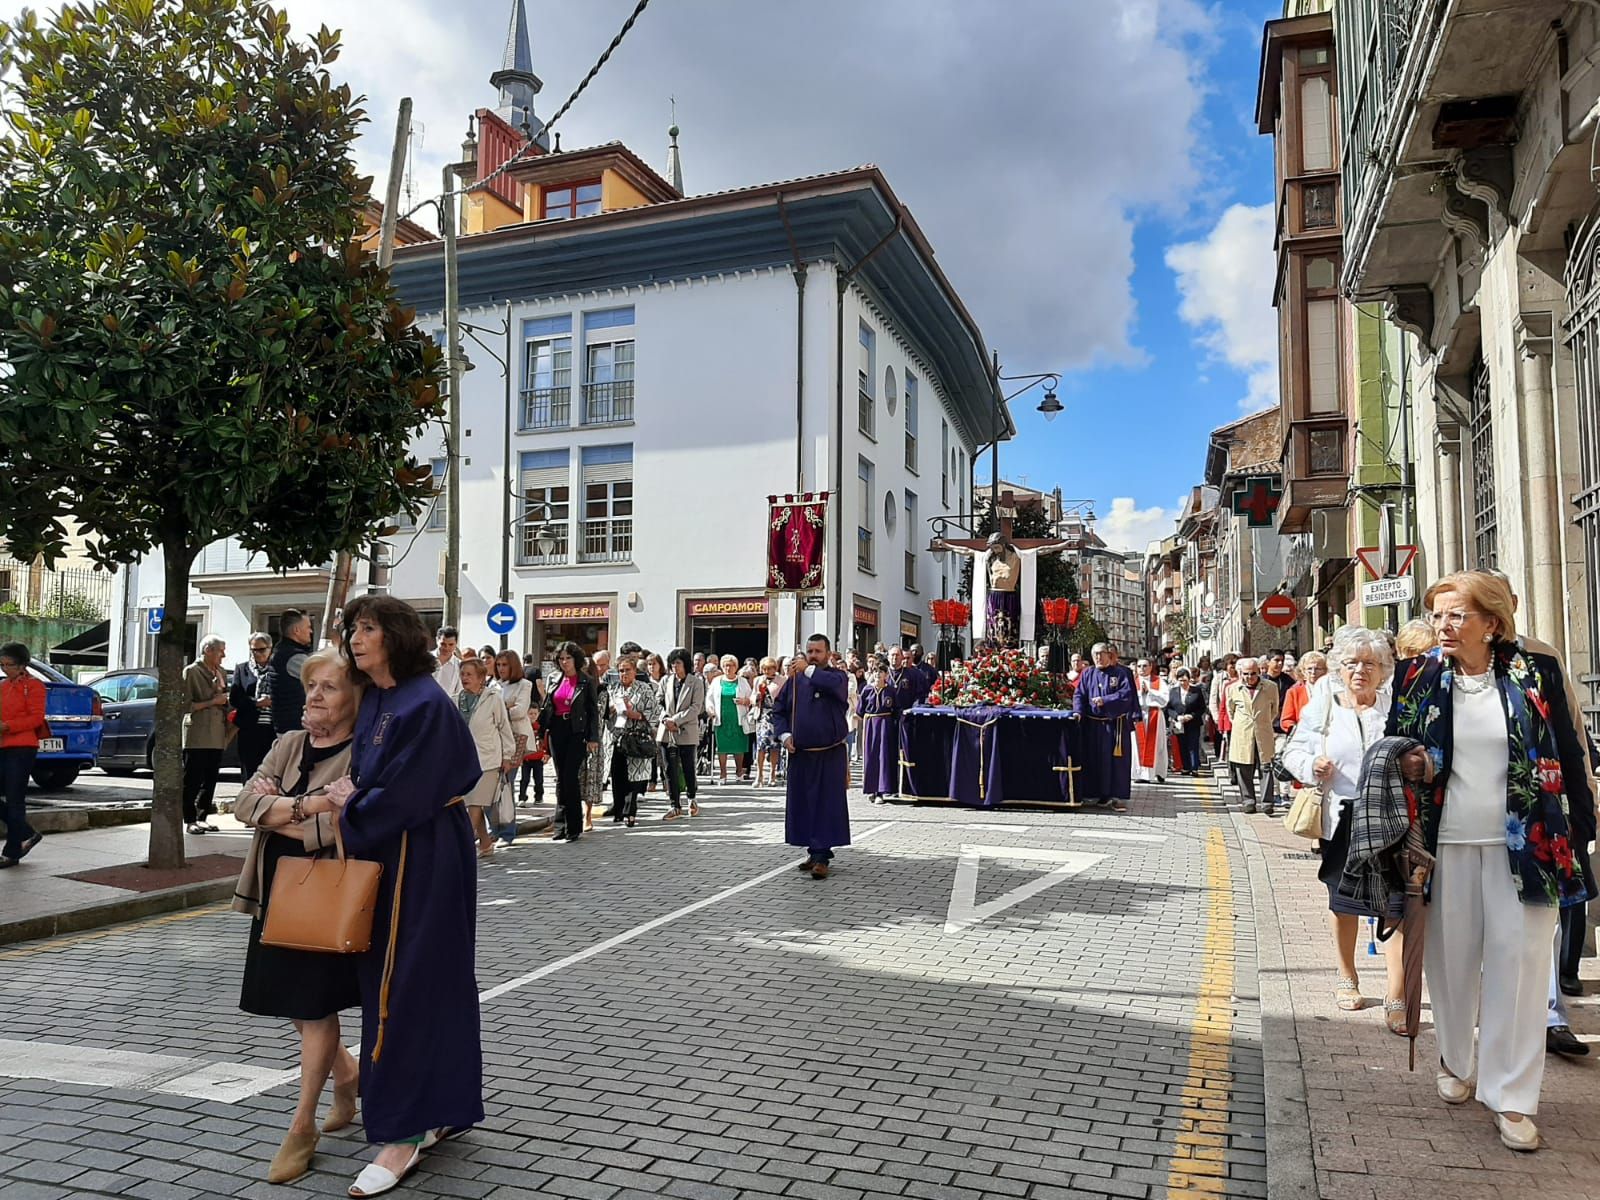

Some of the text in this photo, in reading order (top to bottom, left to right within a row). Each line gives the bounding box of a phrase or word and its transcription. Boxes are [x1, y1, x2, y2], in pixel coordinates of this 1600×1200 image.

[1371, 581, 1402, 593] EXCEPTO
[1365, 589, 1407, 602] RESIDENTES
[694, 602, 762, 613] CAMPOAMOR
[43, 740, 62, 749] FTN
